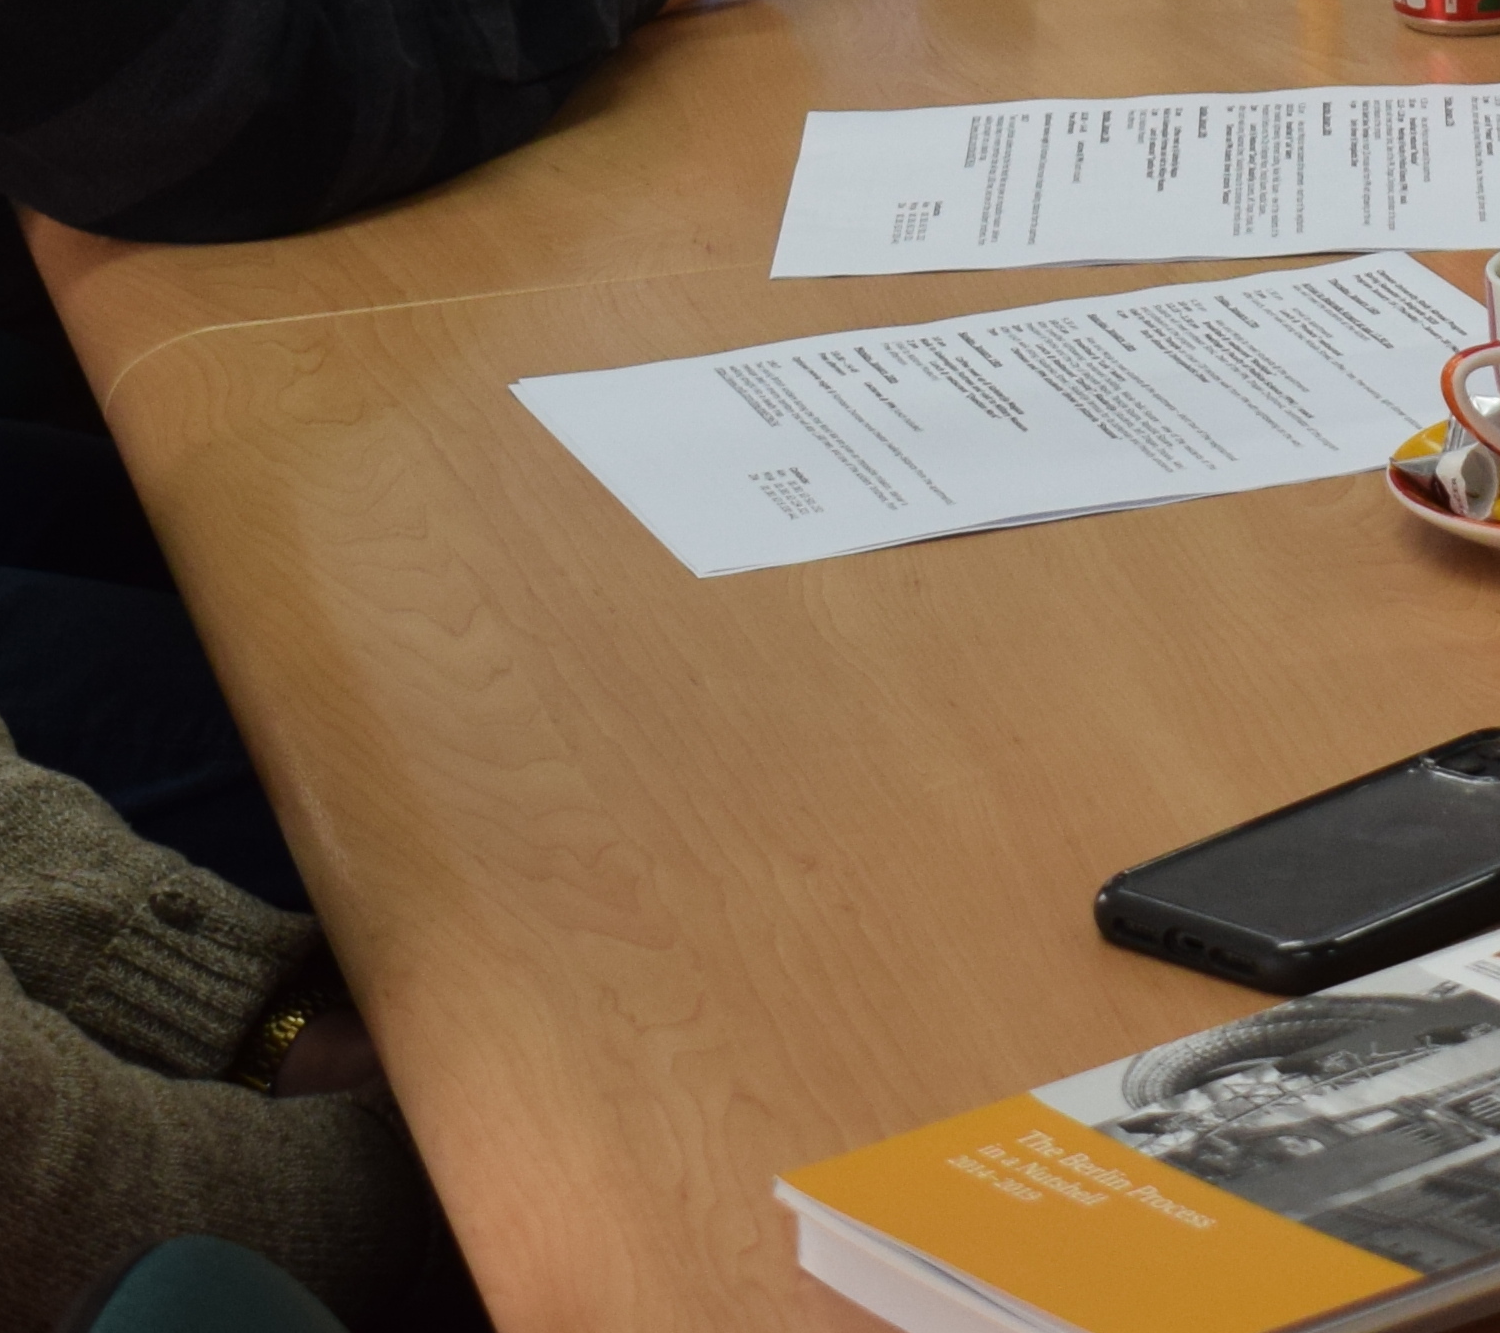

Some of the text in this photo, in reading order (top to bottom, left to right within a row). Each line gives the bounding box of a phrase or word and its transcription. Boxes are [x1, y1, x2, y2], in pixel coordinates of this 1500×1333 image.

[976, 1142, 1110, 1207] in a Nutshell
[1015, 1129, 1217, 1229] The Berlin Process
